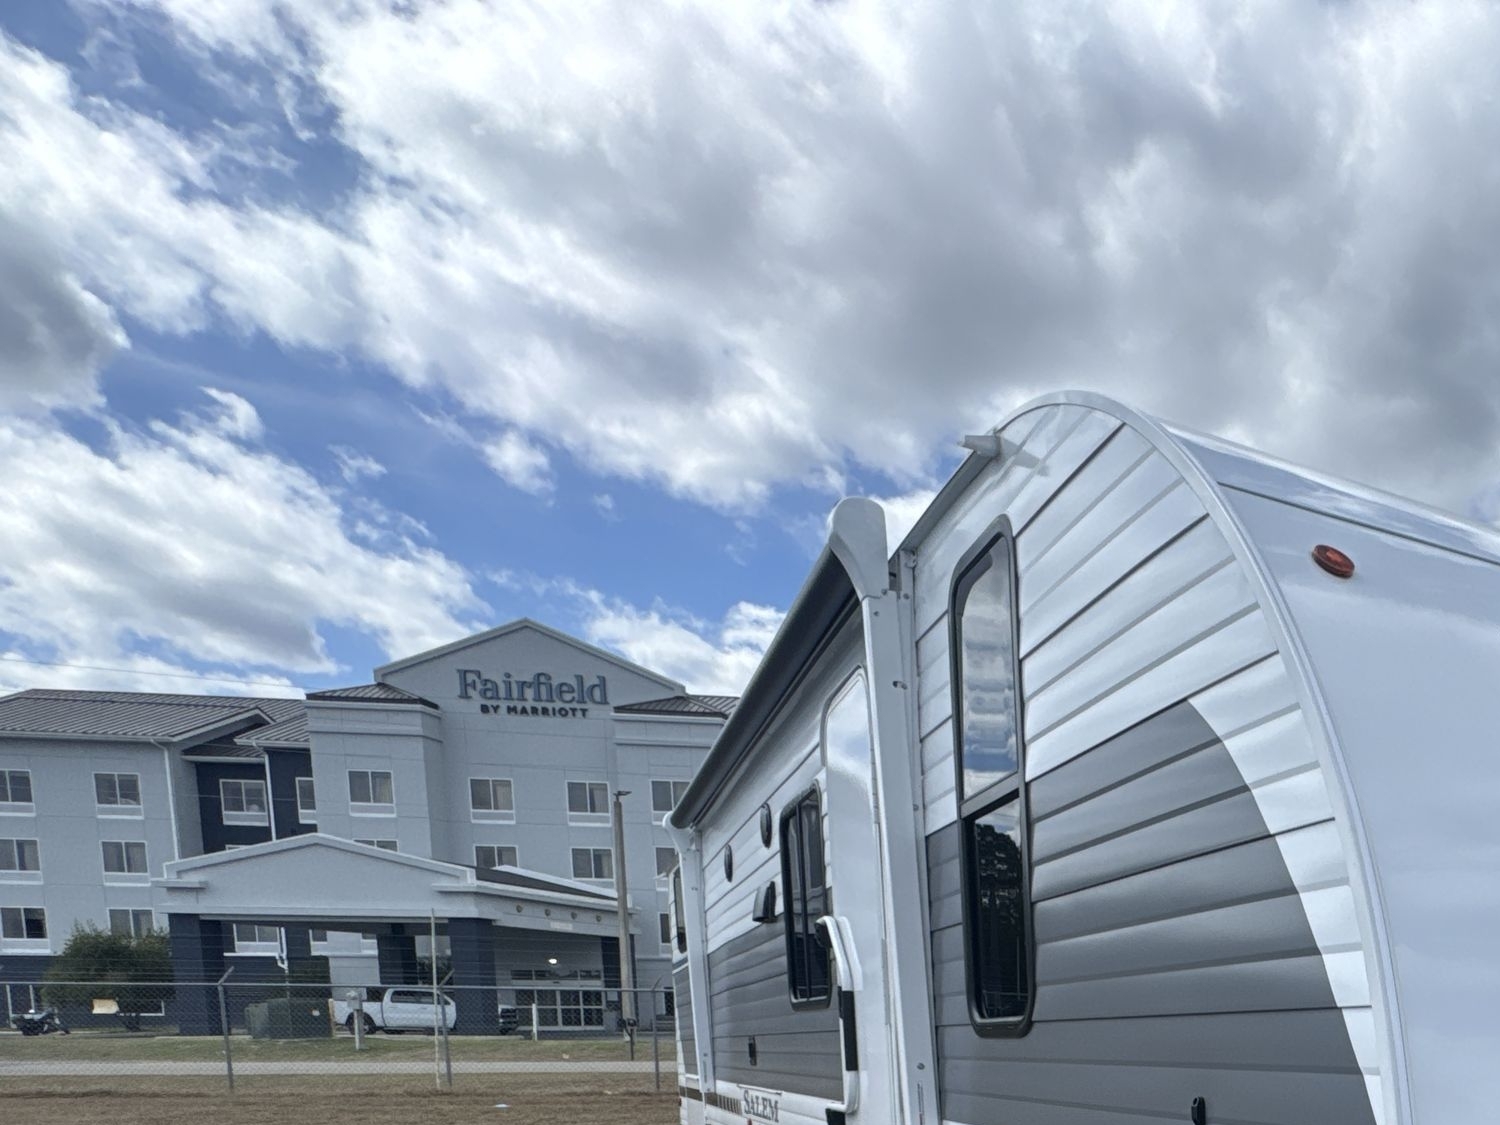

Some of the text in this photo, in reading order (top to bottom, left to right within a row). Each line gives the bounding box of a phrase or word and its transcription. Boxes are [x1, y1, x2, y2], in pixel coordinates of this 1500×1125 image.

[456, 668, 610, 706] Fairfield
[480, 704, 589, 719] BY MARRIOTT
[743, 1089, 779, 1123] SALEM
